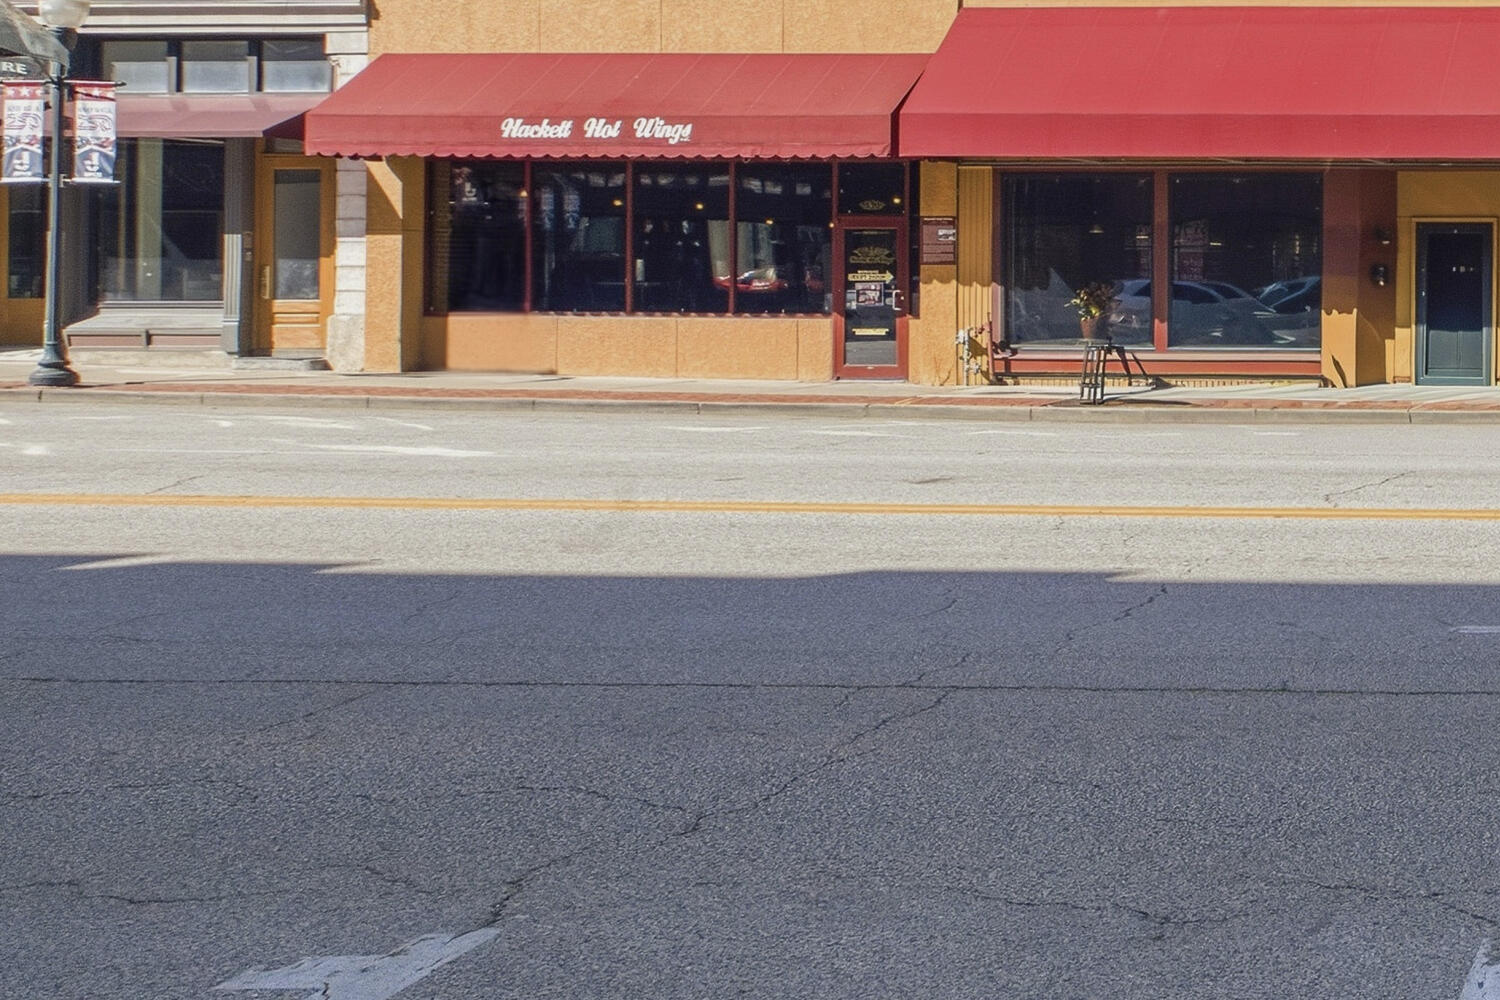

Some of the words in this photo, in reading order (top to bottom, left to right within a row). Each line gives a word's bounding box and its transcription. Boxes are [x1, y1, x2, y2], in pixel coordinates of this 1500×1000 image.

[500, 117, 574, 139] Hackett
[583, 117, 622, 139] Hot
[633, 116, 693, 145] Wings
